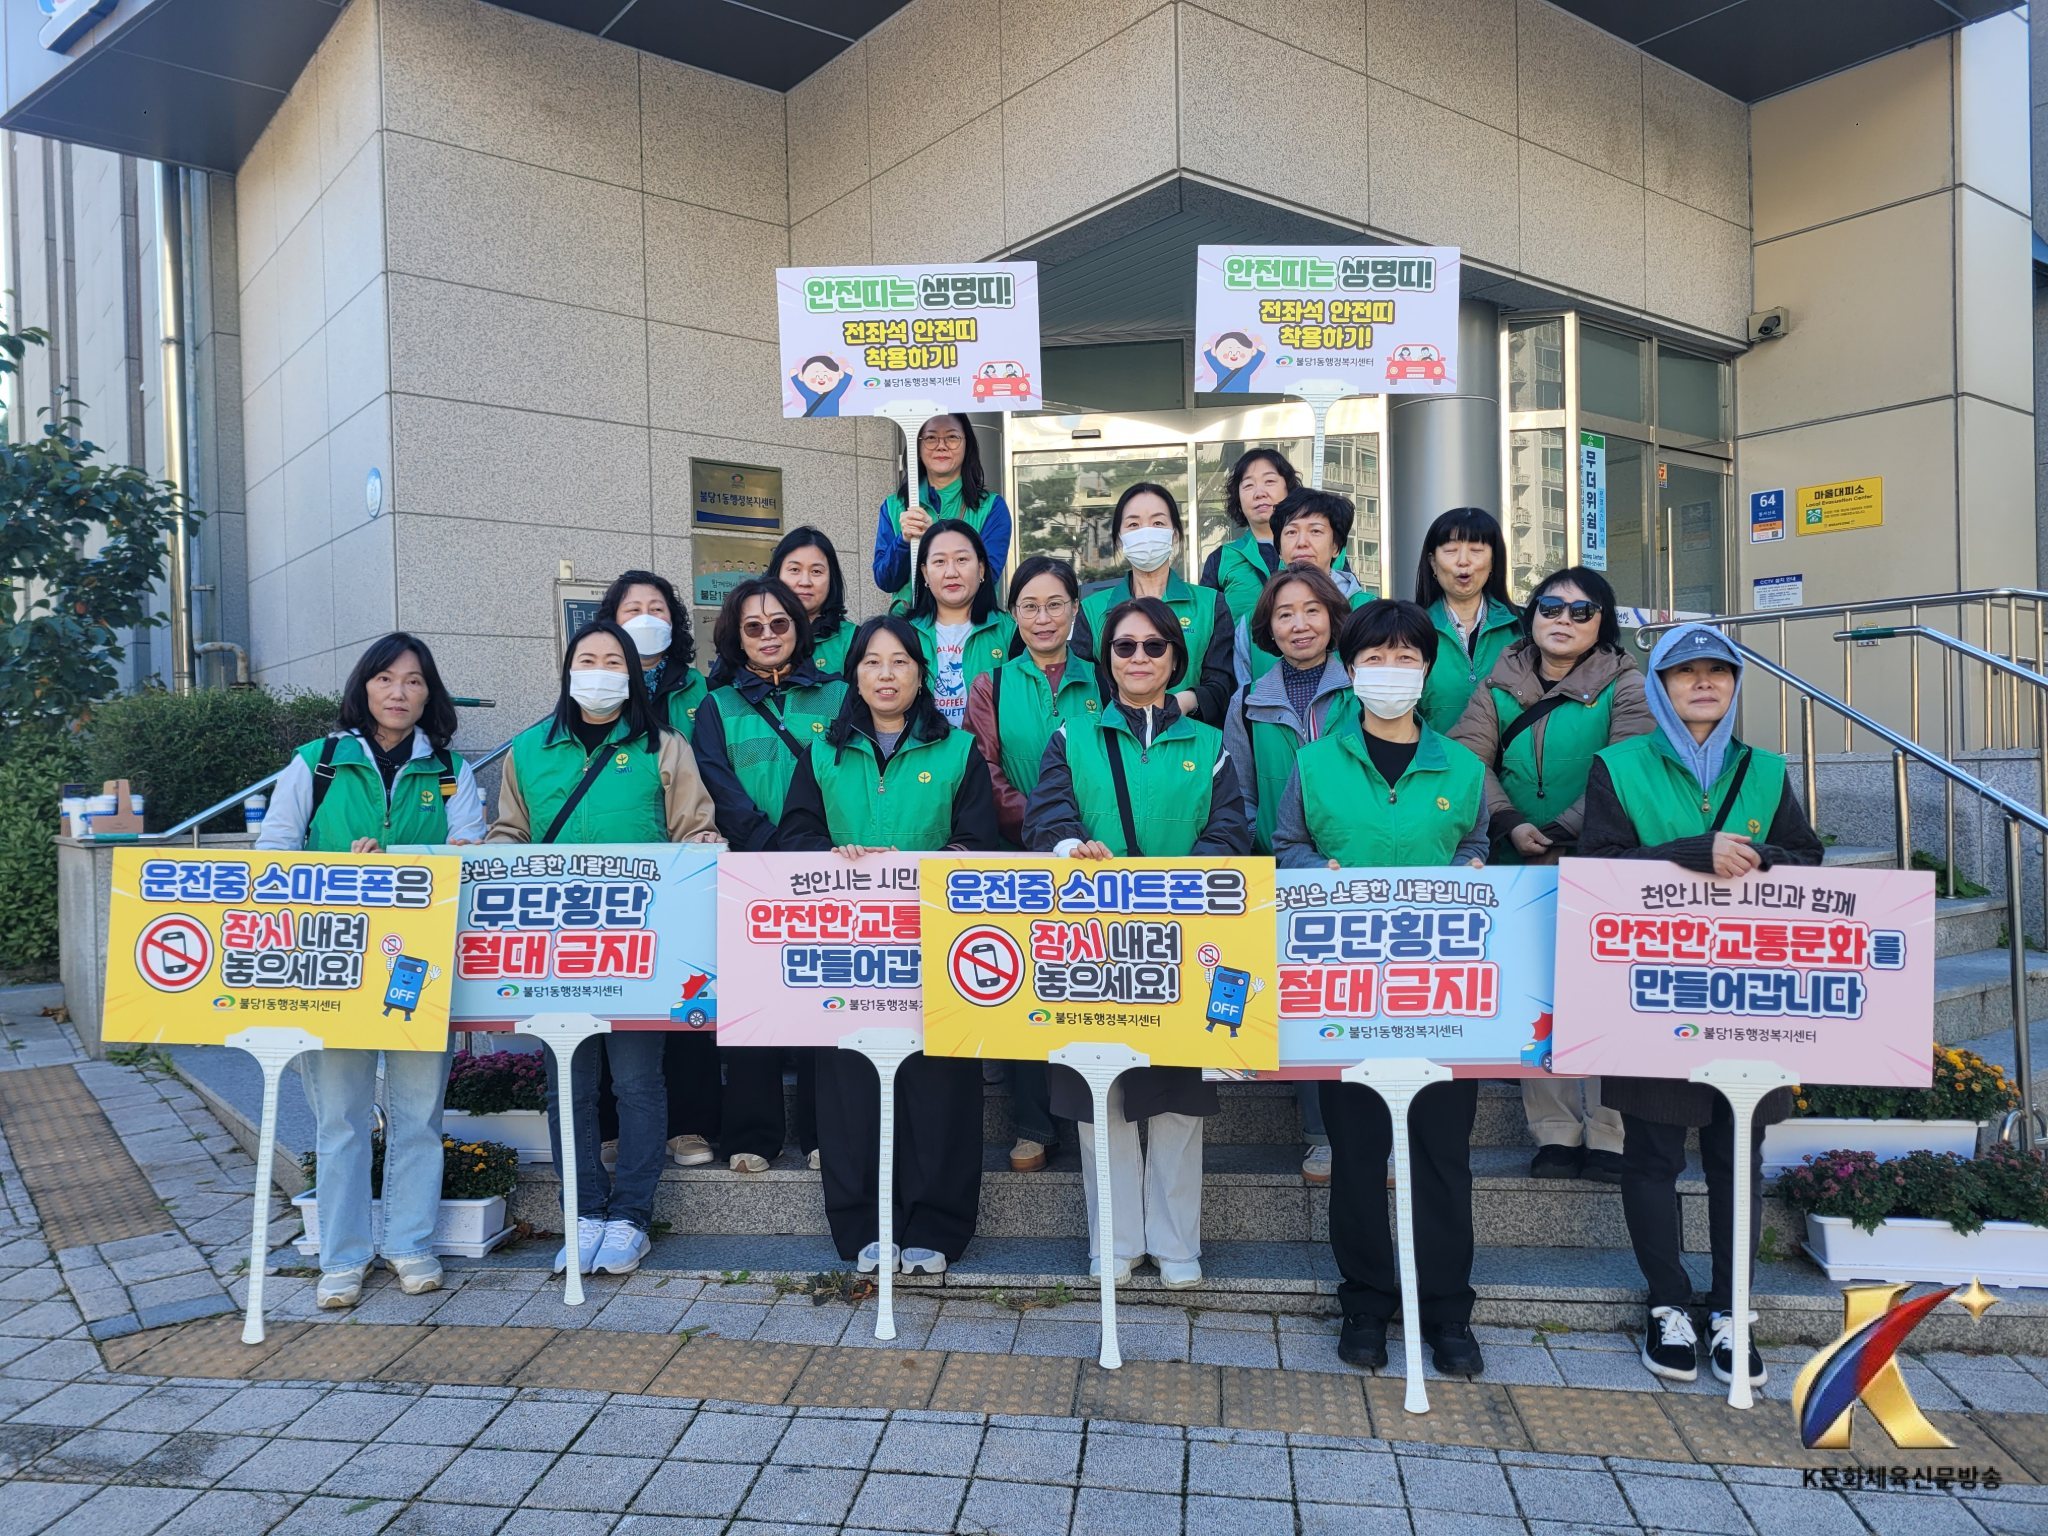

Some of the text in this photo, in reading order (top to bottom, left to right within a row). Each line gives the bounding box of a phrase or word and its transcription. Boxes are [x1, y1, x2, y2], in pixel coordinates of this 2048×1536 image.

[1225, 256, 1434, 290] 안전띠는 생명띠!
[805, 275, 1012, 311] 안전띠는 생명띠!
[1259, 299, 1394, 324] 전좌석 안전띠
[843, 317, 977, 345] 전좌석 안전띠
[1279, 326, 1373, 349] 착용하기!
[865, 344, 958, 371] 착용하기!
[1296, 356, 1374, 367] 불당1동행정복지센터
[883, 376, 960, 388] 불당1동행정복지센터
[700, 490, 777, 510] 불당1동행정복지센터
[1586, 450, 1598, 551] 무더위쉼터
[1760, 494, 1776, 507] 64
[1814, 485, 1865, 500] 마을대피소
[511, 855, 564, 878] 소중한
[569, 855, 660, 881] 사람입니다.
[790, 868, 920, 895] 천안시는 시민
[142, 861, 432, 907] 운전중 스마트폰은
[948, 870, 1245, 913] 운전중 스마트폰은
[1276, 879, 1499, 912] 당신은 소중한 사람입니다.
[1641, 882, 1856, 916] 천안시는 시민과 함께
[471, 881, 652, 930] 무단횡단
[222, 910, 369, 952] 잠시 내려
[748, 900, 853, 942] 안전한
[1287, 908, 1490, 961] 무단횡단
[1030, 919, 1181, 964] 잠시 내려
[1592, 915, 1712, 962] 안전한
[459, 931, 656, 978] 절대 금지!
[222, 952, 363, 989] 놓으세요!
[1034, 963, 1181, 1003] 놓으세요!
[389, 987, 416, 1003] OFF
[523, 985, 623, 998] 불당1동행정복지센터
[1278, 962, 1497, 1017] 절대 금지!
[1632, 964, 1866, 1018] 만들어갑니다
[239, 997, 341, 1013] 불당1동행정복지센터
[1055, 1011, 1160, 1027] 불당1동행정복지센터
[1211, 1000, 1239, 1018] OFF
[1349, 1024, 1463, 1039] 불당1동행정복지센터
[1703, 1026, 1817, 1043] 불당1동행정복지센터
